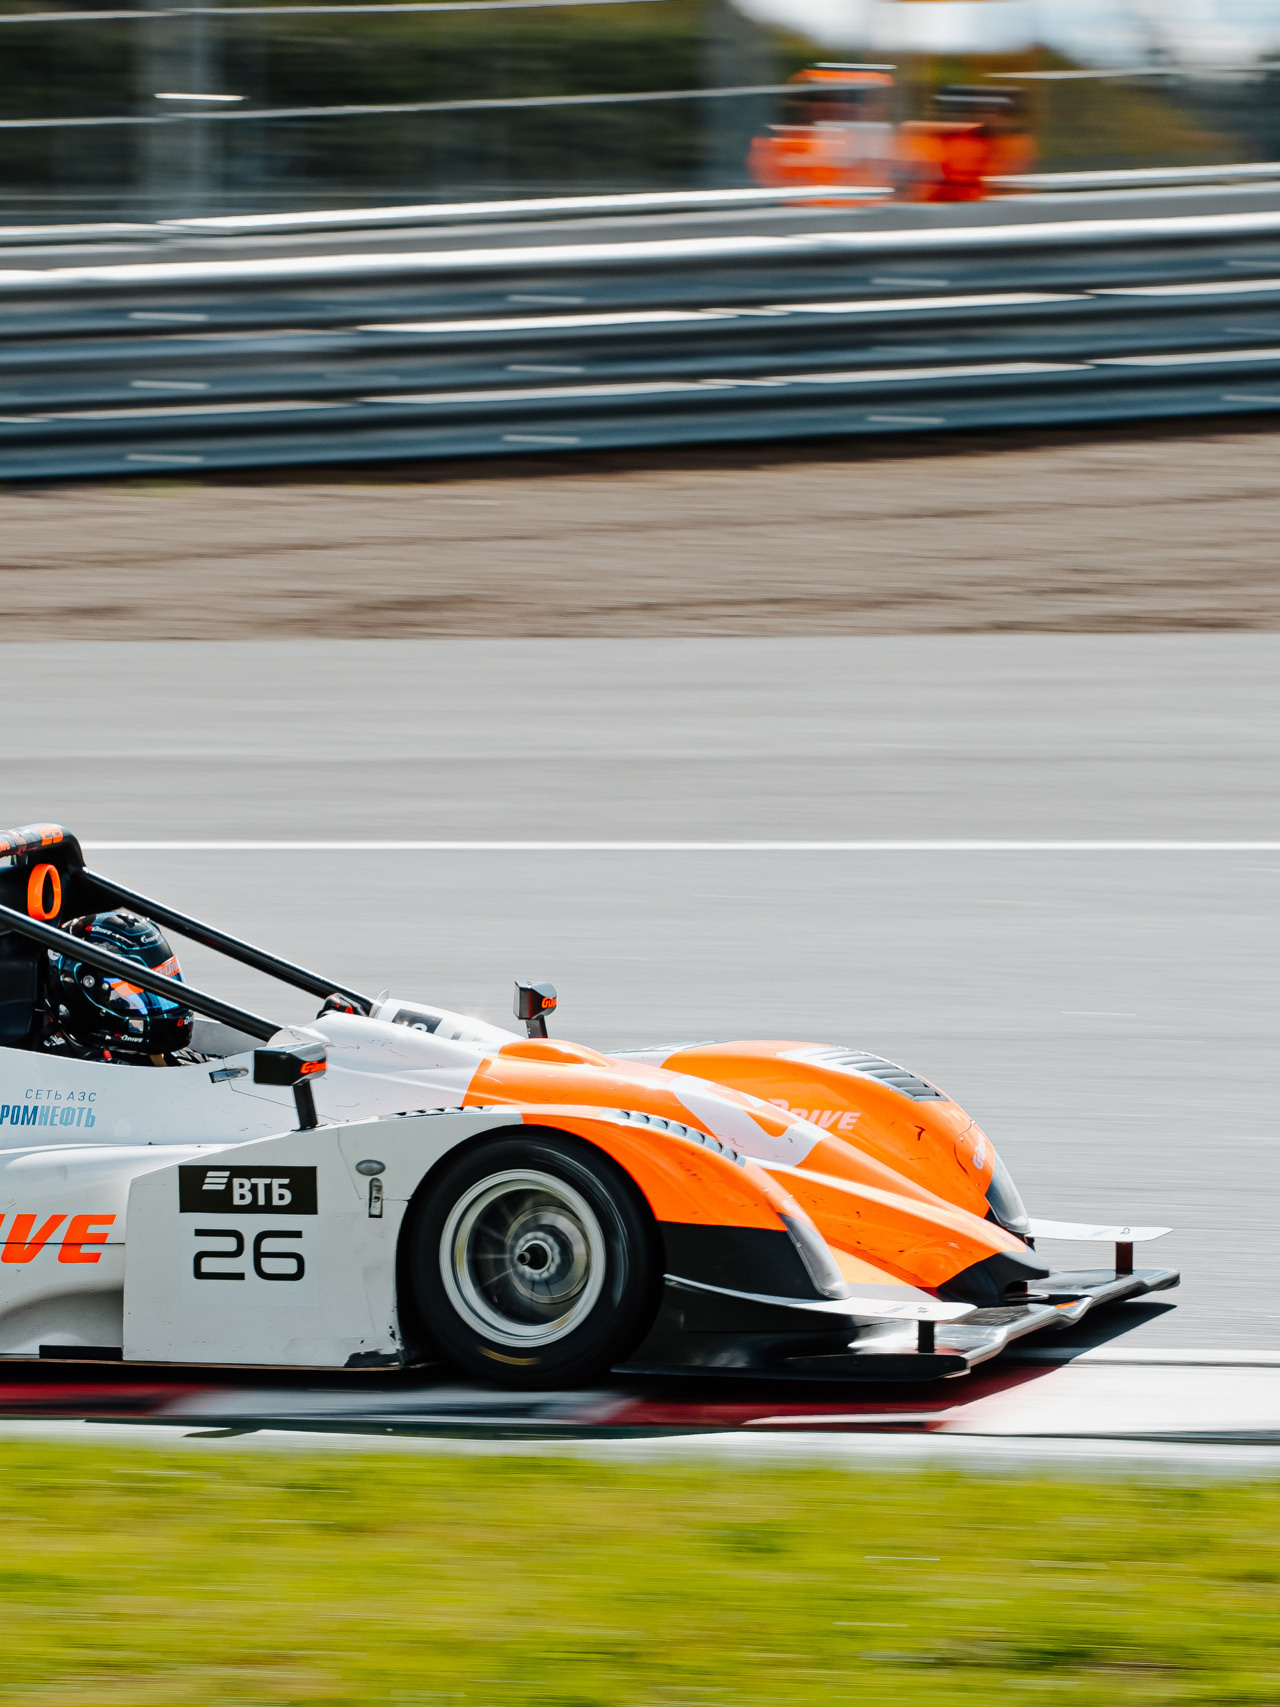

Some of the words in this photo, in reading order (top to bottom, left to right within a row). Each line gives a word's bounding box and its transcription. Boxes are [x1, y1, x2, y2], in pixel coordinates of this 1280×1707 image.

[25, 1088, 63, 1100] СЕТЬ
[66, 1091, 97, 1102] АЗС
[231, 1177, 293, 1206] ВТБ
[193, 1228, 306, 1281] 26
